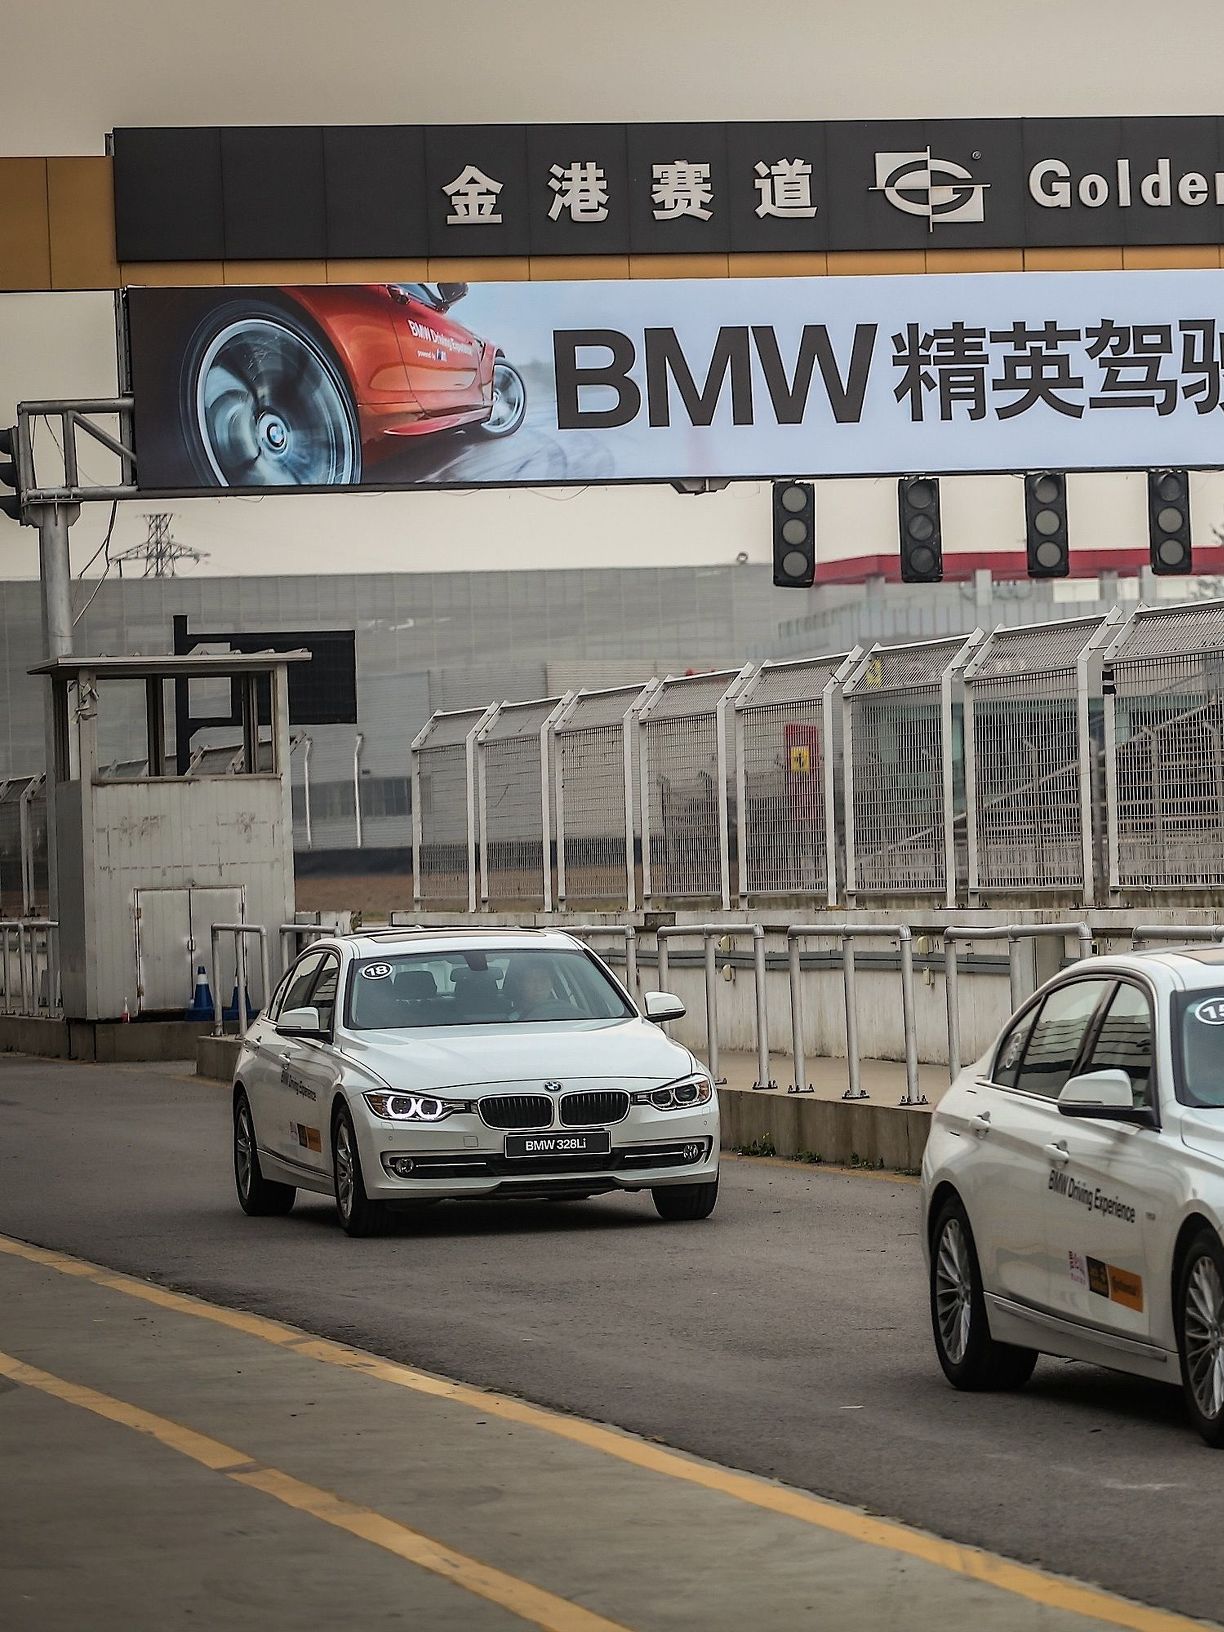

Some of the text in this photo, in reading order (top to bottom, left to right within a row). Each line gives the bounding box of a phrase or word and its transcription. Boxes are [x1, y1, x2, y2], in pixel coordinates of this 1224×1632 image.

[441, 158, 818, 226] 金港赛道
[407, 319, 431, 342] BMW
[552, 323, 878, 430] BMW
[366, 965, 389, 976] 18
[525, 1138, 587, 1151] BMW 328Li
[1048, 1169, 1136, 1223] BMW Driving Experience
